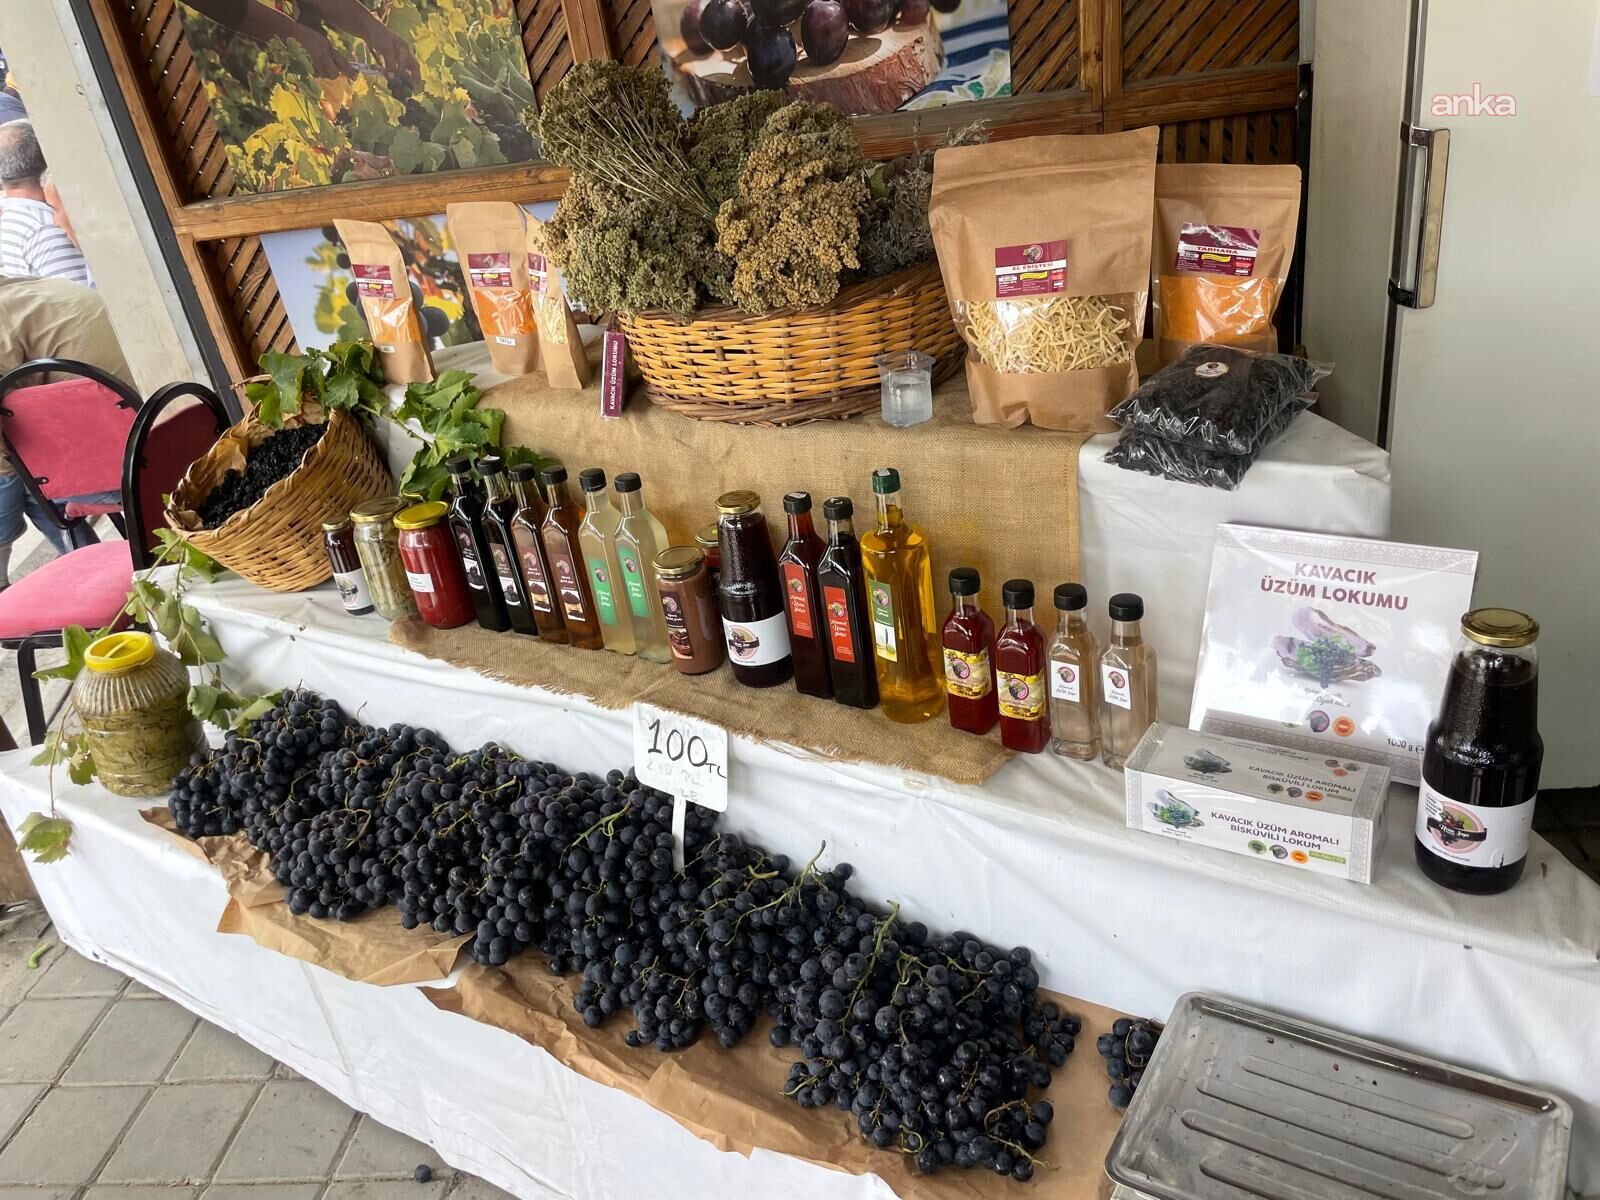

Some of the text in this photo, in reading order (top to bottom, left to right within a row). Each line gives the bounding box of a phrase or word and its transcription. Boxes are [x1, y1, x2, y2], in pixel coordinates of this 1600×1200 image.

[1197, 246, 1239, 255] TARHANA
[611, 340, 619, 367] LOKUMU
[1294, 563, 1377, 585] KAVACIK
[1260, 575, 1408, 611] ÜZÜM LOKUMU
[1248, 766, 1357, 793] KAVACIK ÜZÜM AROMALI
[1306, 784, 1340, 795] LOKUM
[1211, 811, 1340, 846] KAVACIK ÜZÜM AROMALI
[1230, 824, 1321, 850] BİSKÜVİLİ LOKUM
